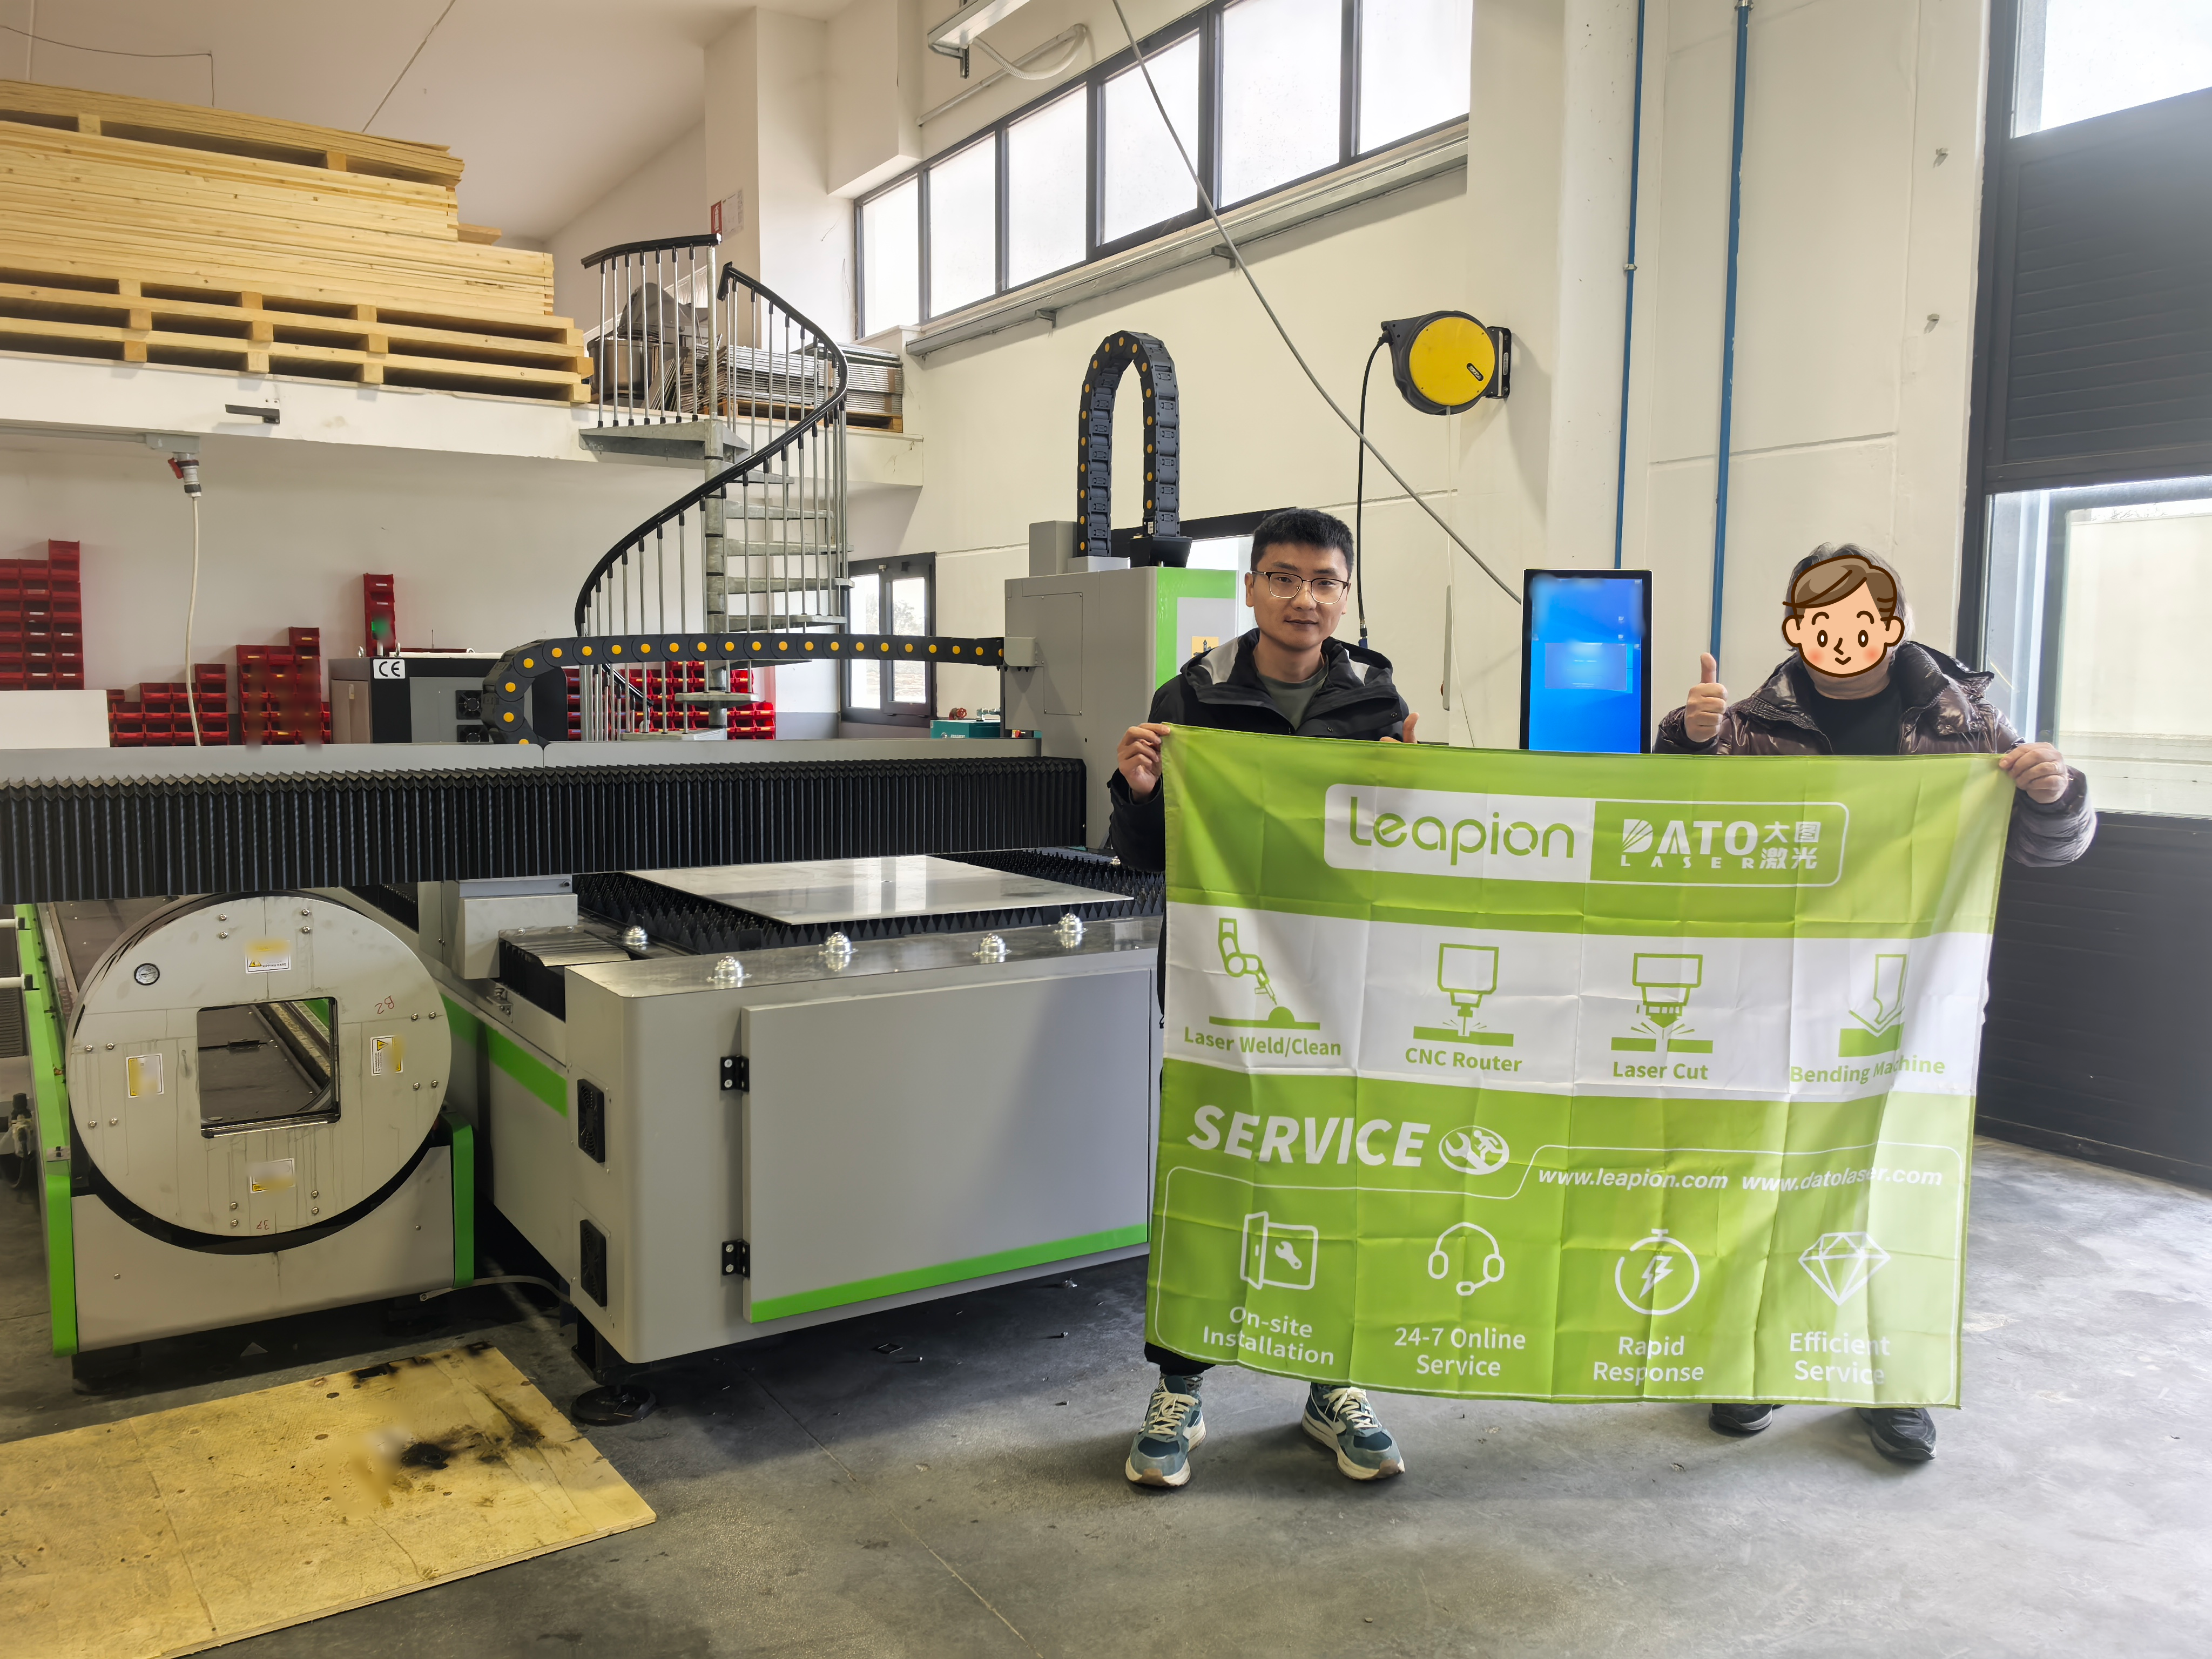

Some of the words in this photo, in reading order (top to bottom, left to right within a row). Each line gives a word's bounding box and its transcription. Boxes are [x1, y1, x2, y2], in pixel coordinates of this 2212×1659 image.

[1350, 796, 1575, 866] Leapion
[1621, 818, 1758, 857] DATO
[1763, 821, 1821, 844] 大图
[1620, 857, 1754, 869] LASER
[1759, 847, 1818, 870] 激光
[1184, 1026, 1235, 1051] Laser
[1239, 1036, 1342, 1058] Weld/Clean
[1405, 1047, 1447, 1065] CNC
[1452, 1051, 1523, 1072] Router
[1613, 1061, 1668, 1080] Laser
[1673, 1062, 1708, 1081] Cut
[1790, 1065, 1870, 1084] Bending
[1873, 1055, 1945, 1076] Machine
[1186, 1104, 1431, 1167] SERVICE
[1538, 1168, 1728, 1191] www.leapion.com
[1742, 1166, 1943, 1192] www.datolaser.com
[1230, 1306, 1313, 1338] On-site
[1203, 1325, 1334, 1366] Installation
[1395, 1326, 1444, 1348] 24-7
[1450, 1327, 1526, 1350] Online
[1618, 1336, 1684, 1359] Rapid
[1790, 1332, 1891, 1356] Efficient
[1416, 1354, 1501, 1377] Service
[1593, 1360, 1704, 1386] Response
[1794, 1360, 1885, 1385] Service
